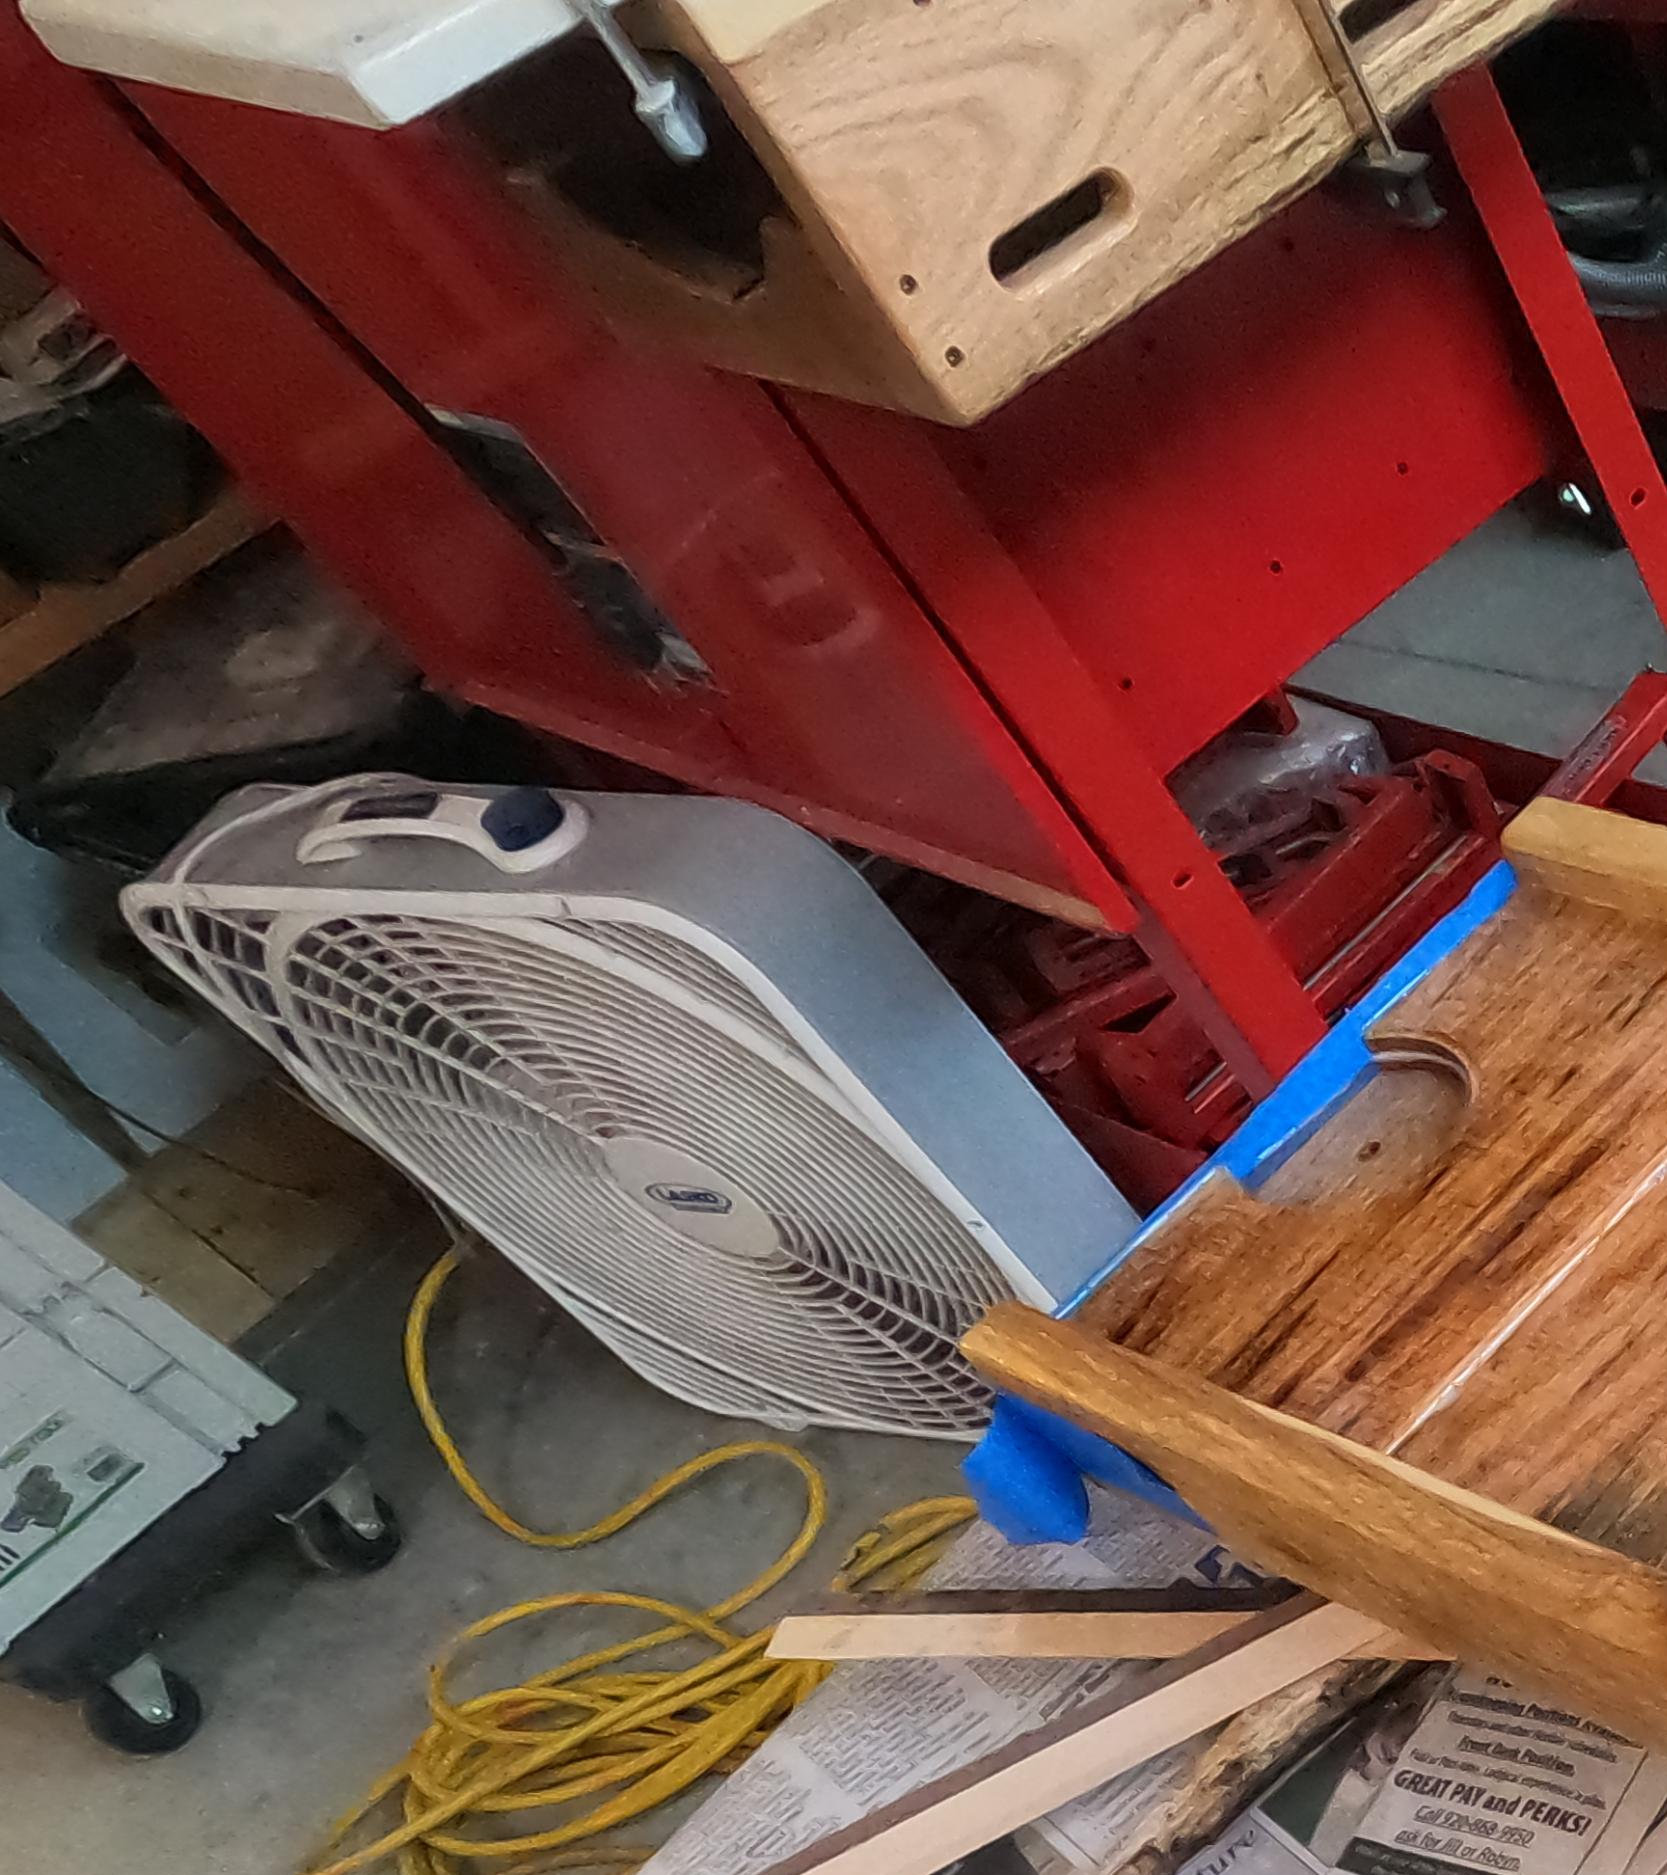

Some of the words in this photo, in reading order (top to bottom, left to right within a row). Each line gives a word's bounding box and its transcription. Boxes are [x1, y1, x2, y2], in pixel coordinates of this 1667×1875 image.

[1392, 1767, 1452, 1801] GREAT
[1448, 1781, 1485, 1808] PAY
[1481, 1788, 1519, 1817] and
[1518, 1799, 1592, 1838] PERKS!
[1414, 1803, 1441, 1824] Call
[1394, 1826, 1420, 1847] ask
[1420, 1831, 1441, 1851] for
